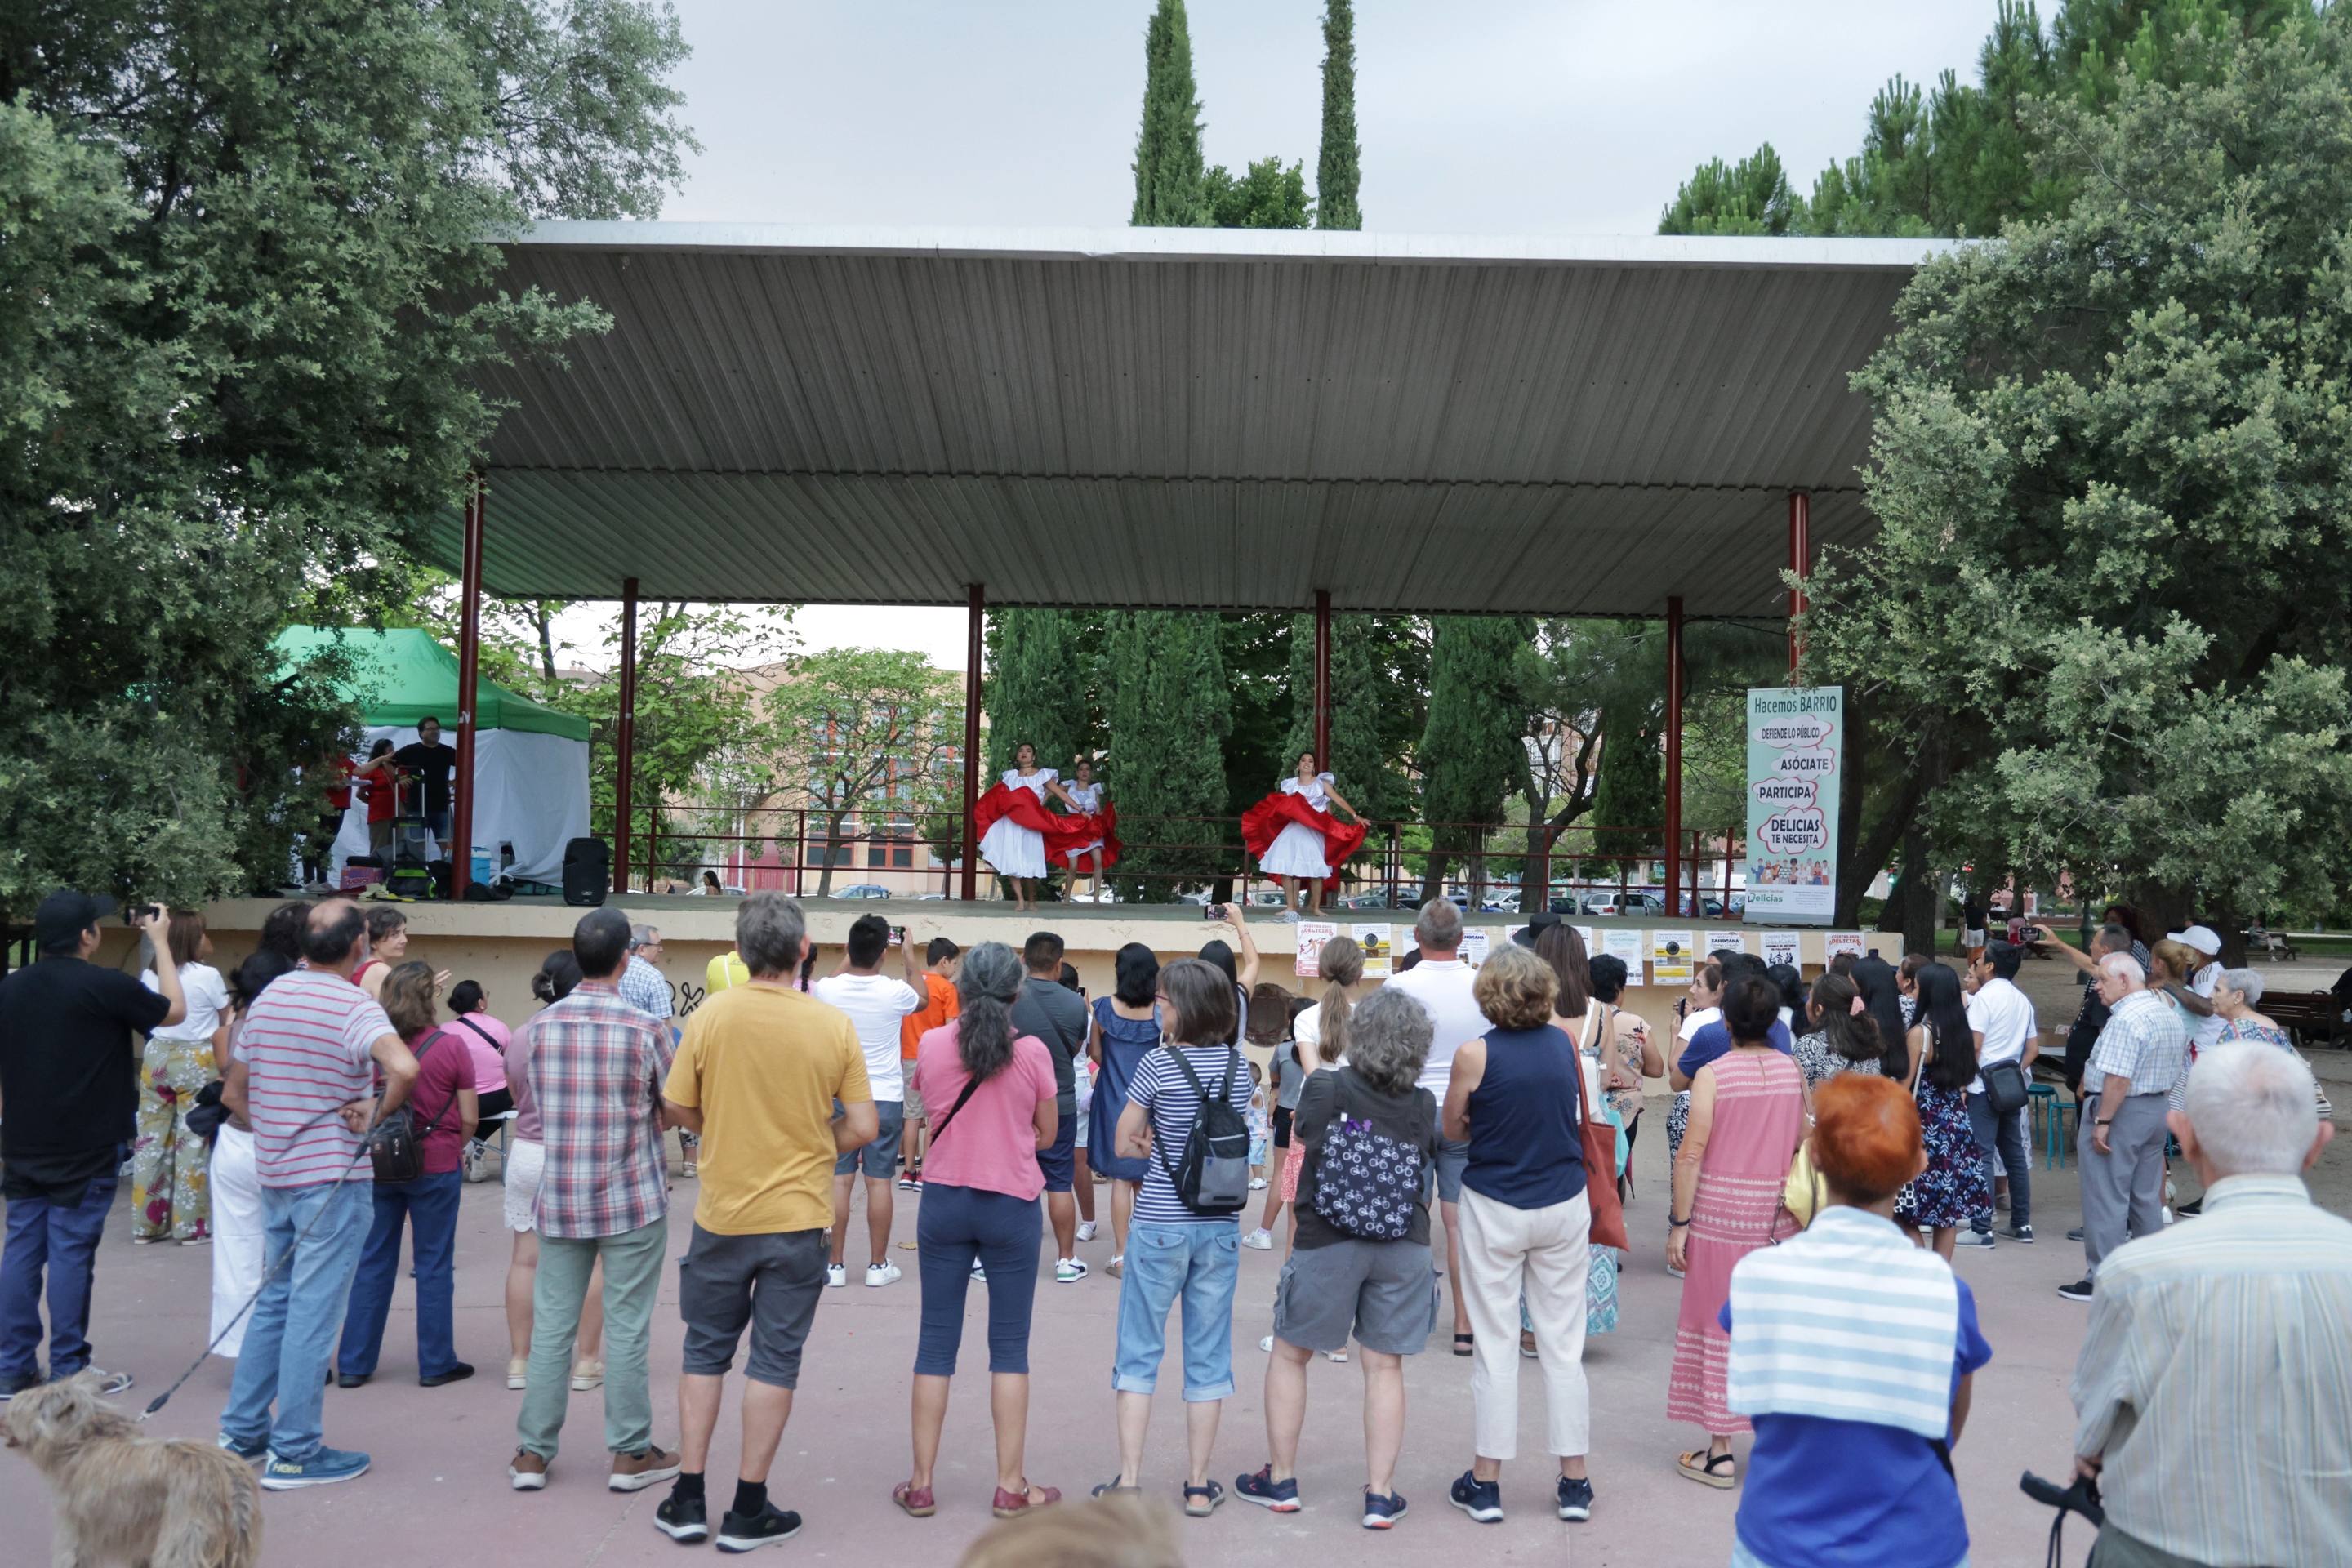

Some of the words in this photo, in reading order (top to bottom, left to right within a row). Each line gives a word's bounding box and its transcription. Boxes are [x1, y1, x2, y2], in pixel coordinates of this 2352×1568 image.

[1754, 697, 1797, 713] Hacemos
[1800, 695, 1837, 712] BARRIO
[1762, 728, 1788, 740] DEFIENDE
[1788, 728, 1796, 739] LO
[1797, 724, 1820, 739] PÚBLICO
[1780, 755, 1829, 770] ASÓCIATE
[1759, 786, 1811, 799] PARTICIPA
[1771, 819, 1820, 832] DELICIAS
[1772, 834, 1780, 844] TE
[1782, 834, 1819, 844] NECESITA
[1748, 893, 1784, 902] Delicias
[273, 1463, 303, 1474] HOKA
